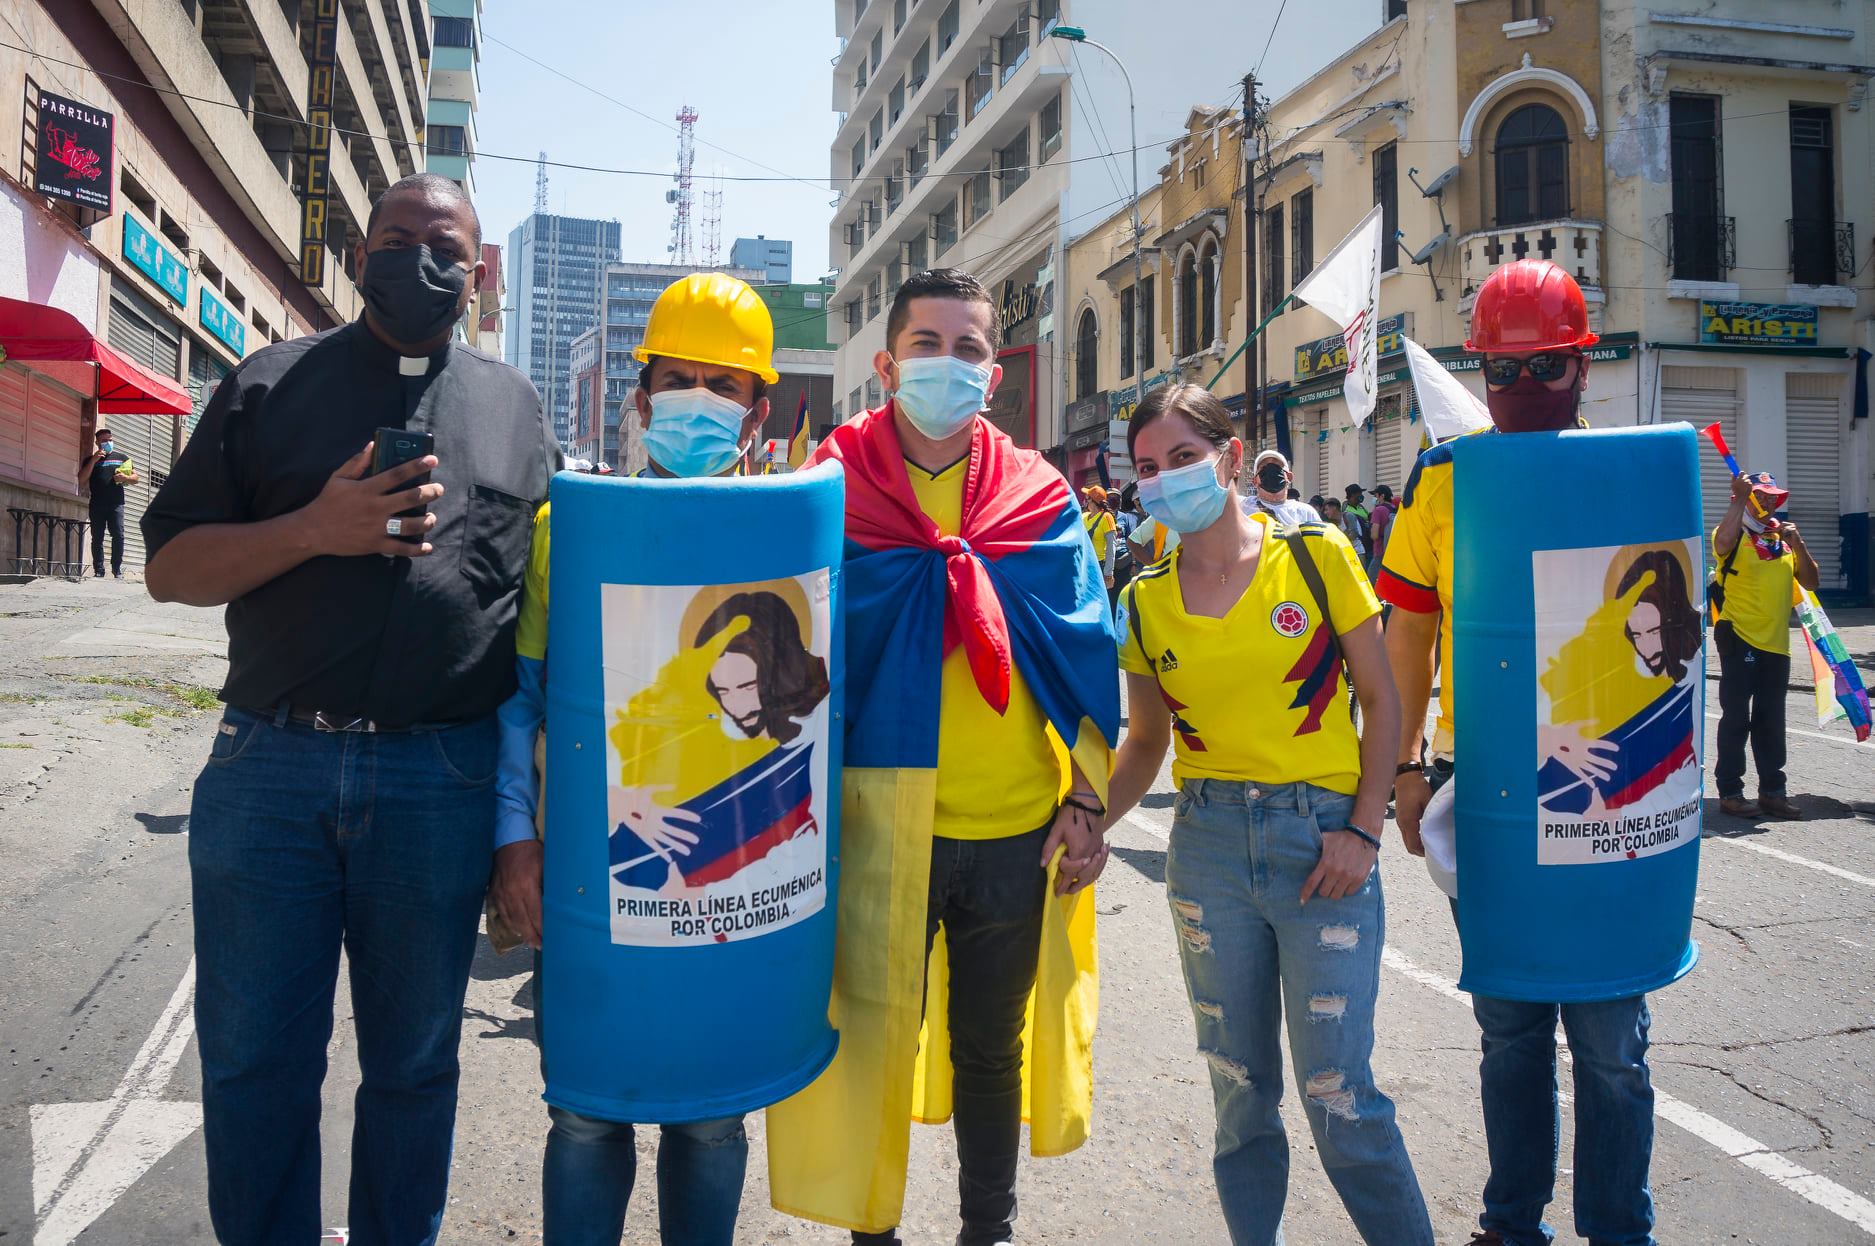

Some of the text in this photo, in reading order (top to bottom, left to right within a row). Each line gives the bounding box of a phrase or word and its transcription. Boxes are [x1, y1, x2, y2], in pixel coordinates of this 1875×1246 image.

[41, 98, 108, 129] PARRILLA
[1706, 317, 1814, 337] ARISTI
[1545, 799, 1699, 838] PRIMERA LÍNEA ECUMÉNICA
[1592, 825, 1679, 854] POR COLOMBIA
[617, 867, 822, 917] PRIMERA LÍNEA ECUMÉNICA
[671, 903, 790, 937] POR COLOMBIA
